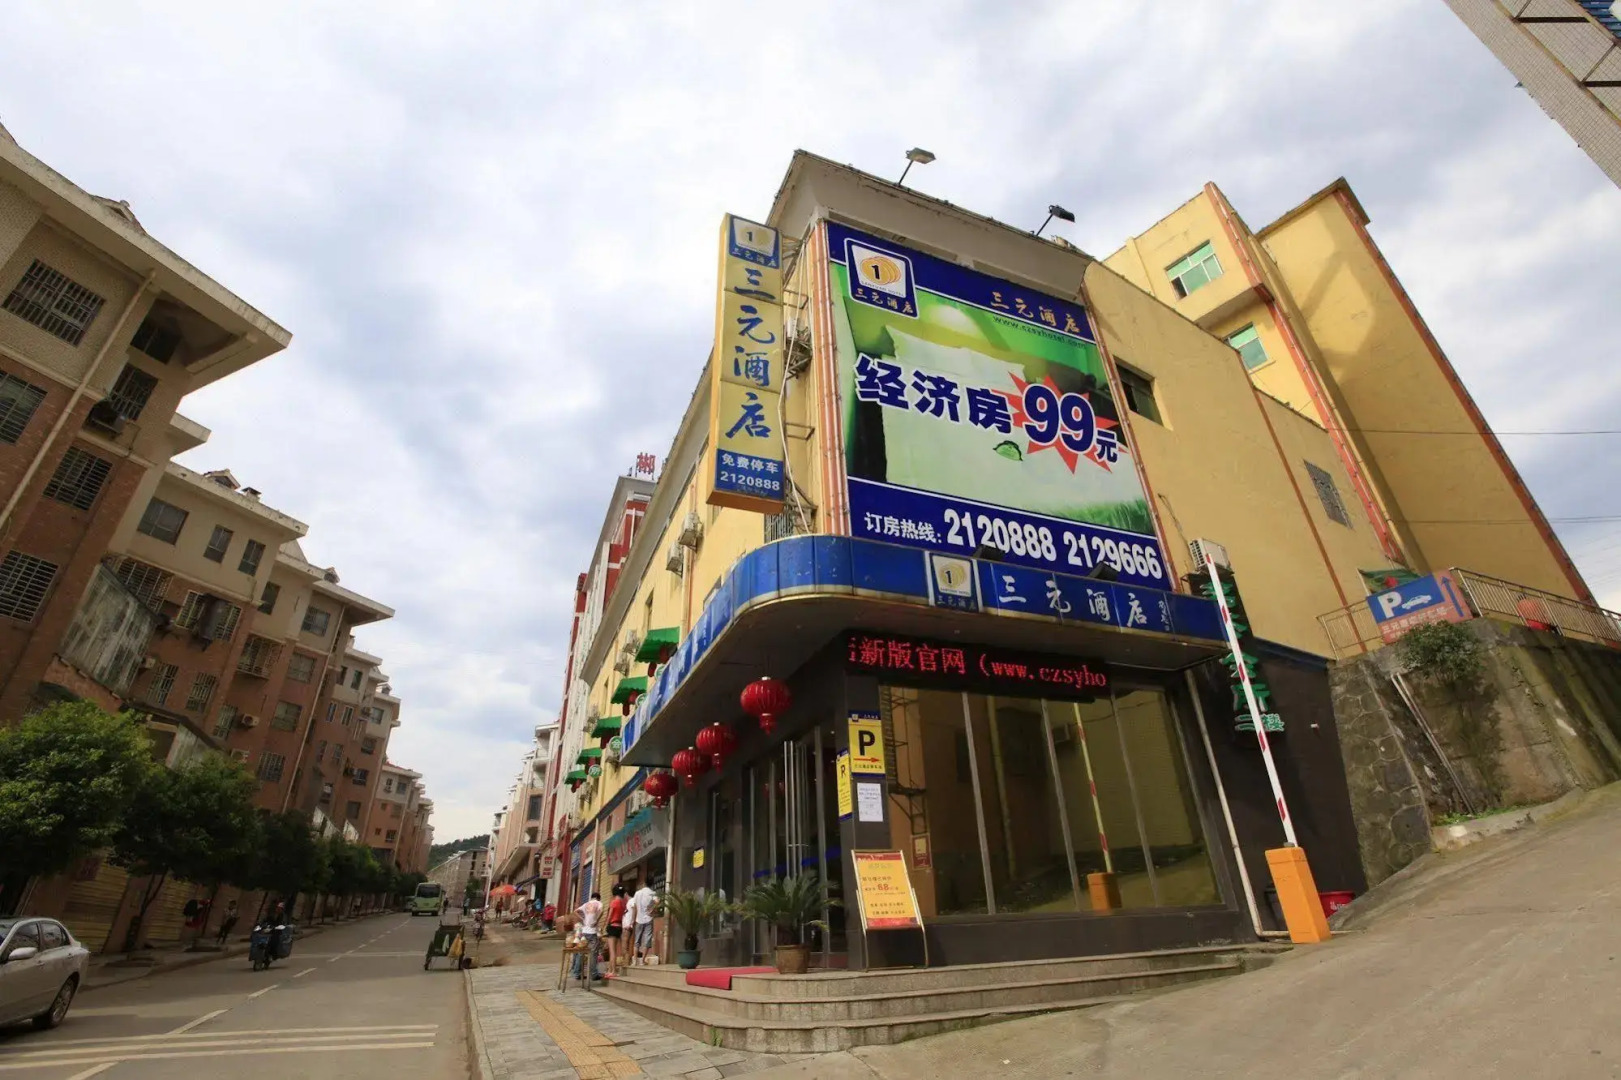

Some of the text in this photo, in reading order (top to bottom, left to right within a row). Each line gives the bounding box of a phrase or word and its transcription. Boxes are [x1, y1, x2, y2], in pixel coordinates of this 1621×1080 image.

[871, 264, 880, 280] 1
[855, 288, 913, 313] 三元酒店
[990, 291, 1080, 333] 三元酒店
[993, 315, 1086, 349] www.czsyhotel.com
[725, 268, 776, 439] 三元酒店
[721, 453, 779, 474] 免费停车
[720, 471, 780, 491] 2120888
[944, 509, 1057, 561] 2120888
[1063, 532, 1163, 579] 2129666
[945, 570, 952, 584] 1
[999, 575, 1148, 627] 三元酒店
[1377, 591, 1402, 619] P
[858, 730, 876, 756] P
